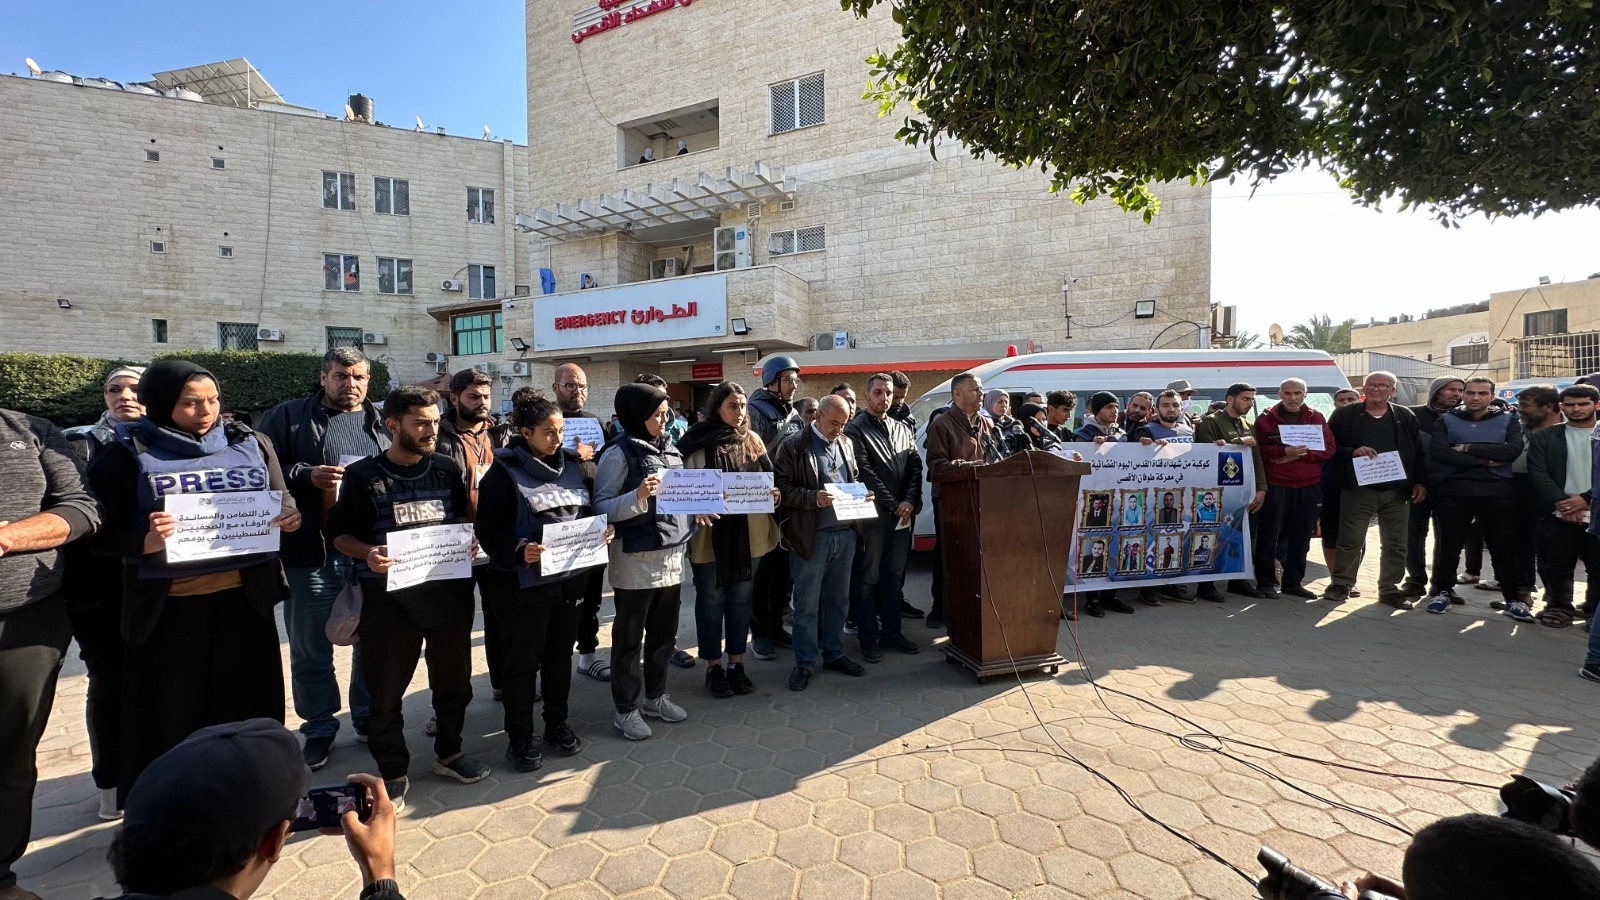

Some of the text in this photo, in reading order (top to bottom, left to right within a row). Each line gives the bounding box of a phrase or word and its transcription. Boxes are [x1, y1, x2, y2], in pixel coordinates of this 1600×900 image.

[572, 11, 620, 43] الأقصى
[631, 302, 698, 325] الطوارئ
[554, 310, 626, 330] EMERGENCY
[1092, 460, 1118, 470] الفضائية
[1118, 460, 1132, 470] اليوم
[1133, 460, 1151, 470] القدس
[1164, 459, 1181, 469] شهداء
[1183, 460, 1191, 469] من
[1192, 460, 1210, 469] كوكبة
[154, 468, 264, 496] PRESS
[1117, 472, 1184, 484] في معركة طوفان الأقصى
[179, 512, 224, 521] والمساندة
[226, 510, 257, 519] التضامن
[177, 523, 224, 533] الصحفيين
[207, 534, 220, 543] في
[222, 530, 270, 540] الفلسطينيين
